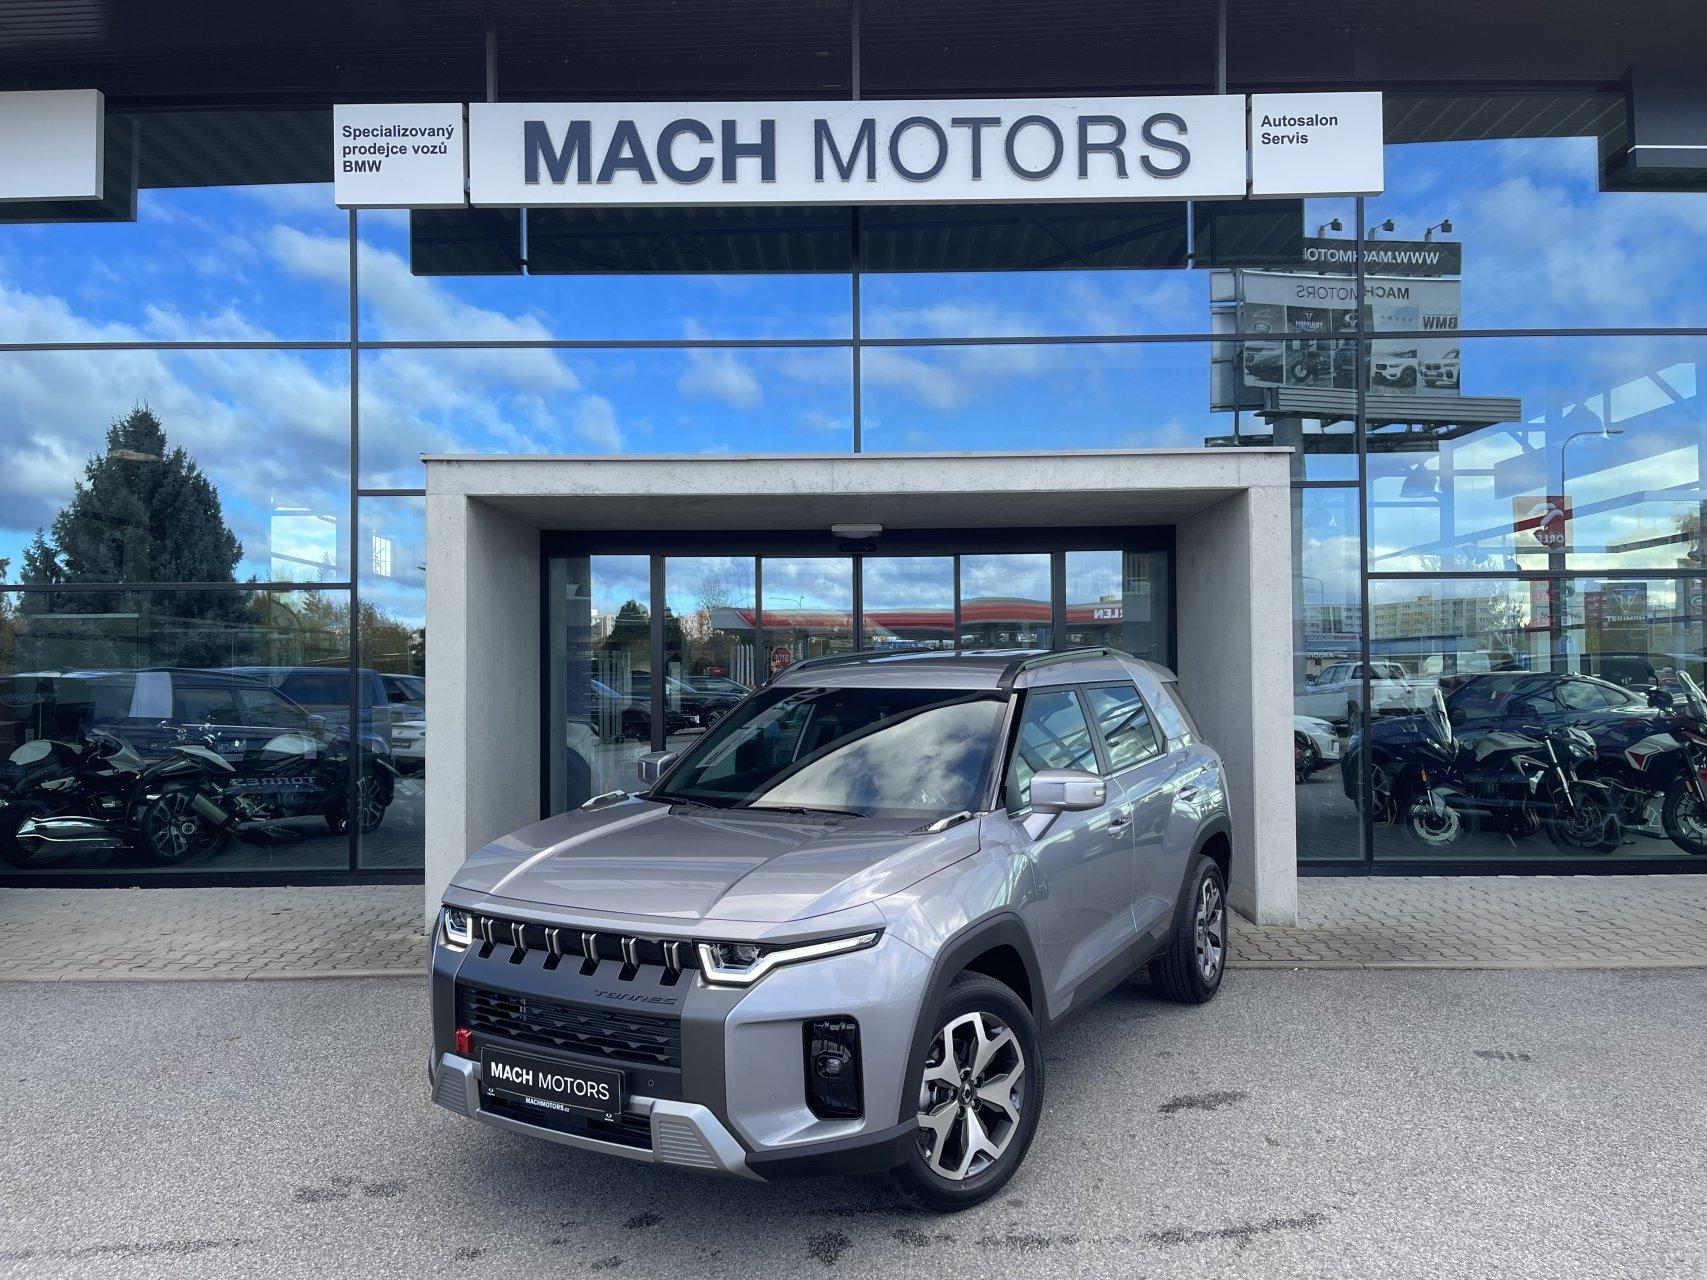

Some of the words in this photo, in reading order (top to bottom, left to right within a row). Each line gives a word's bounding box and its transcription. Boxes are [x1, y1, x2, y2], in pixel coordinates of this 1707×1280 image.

[1261, 113, 1339, 128] Autosalon
[342, 124, 455, 140] Specializovaný
[1261, 131, 1309, 145] Servis
[342, 143, 408, 158] prodejce
[411, 141, 448, 155] vozů
[523, 115, 776, 185] MACH
[813, 111, 1192, 182] MOTORS
[342, 160, 382, 173] BMW
[490, 1061, 533, 1086] MACH
[538, 1072, 610, 1101] MOTORS
